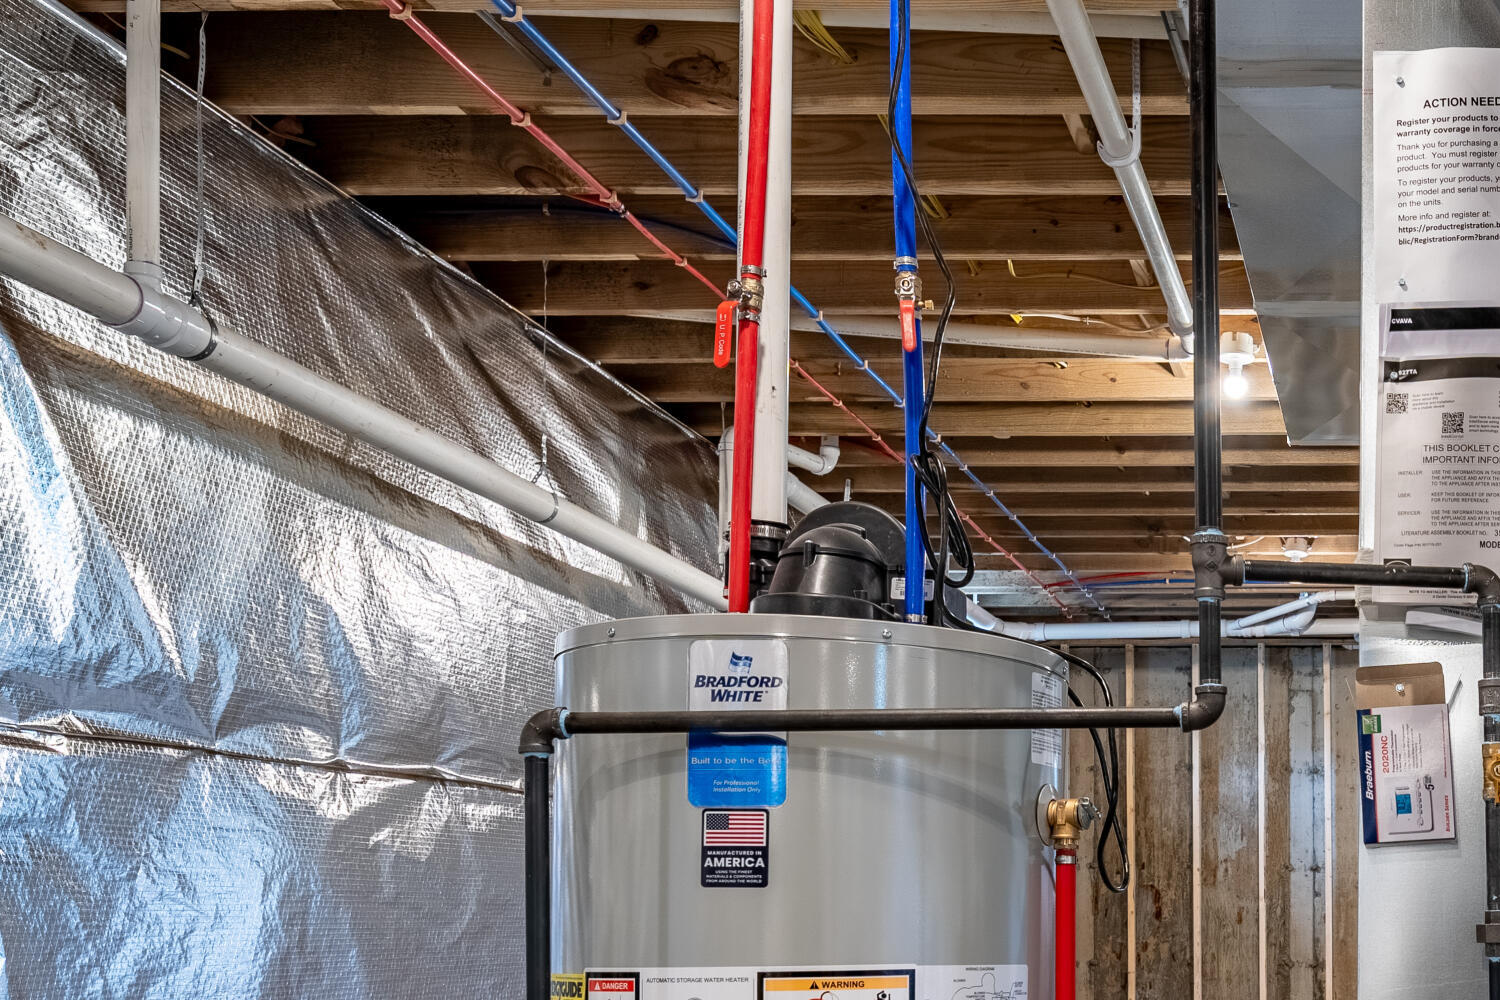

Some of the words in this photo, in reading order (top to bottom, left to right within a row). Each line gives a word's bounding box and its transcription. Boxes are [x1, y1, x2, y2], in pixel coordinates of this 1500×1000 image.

[1423, 97, 1467, 108] ACTION
[1396, 118, 1430, 127] Register
[1431, 116, 1450, 125] your
[1452, 115, 1488, 123] products
[1396, 129, 1431, 137] warranty
[1450, 140, 1492, 148] purchasing
[1469, 151, 1498, 159] register
[1397, 164, 1430, 173] products
[1443, 162, 1460, 170] your
[1409, 178, 1437, 186] register
[1439, 177, 1457, 185] your
[1458, 175, 1493, 183] products,
[1397, 191, 1414, 199] your
[1398, 214, 1418, 222] More
[1435, 212, 1450, 220] and
[1451, 211, 1480, 220] register
[1424, 444, 1444, 452] THIS
[1446, 444, 1491, 452] BOOKLET
[694, 675, 783, 688] BRADFORD
[711, 689, 763, 702] WHITE
[1381, 736, 1389, 773] 2020NC
[1365, 751, 1374, 800] Braeburn
[704, 858, 765, 868] AMERICA
[602, 982, 628, 990] DANGER
[822, 981, 865, 989] WARNING
